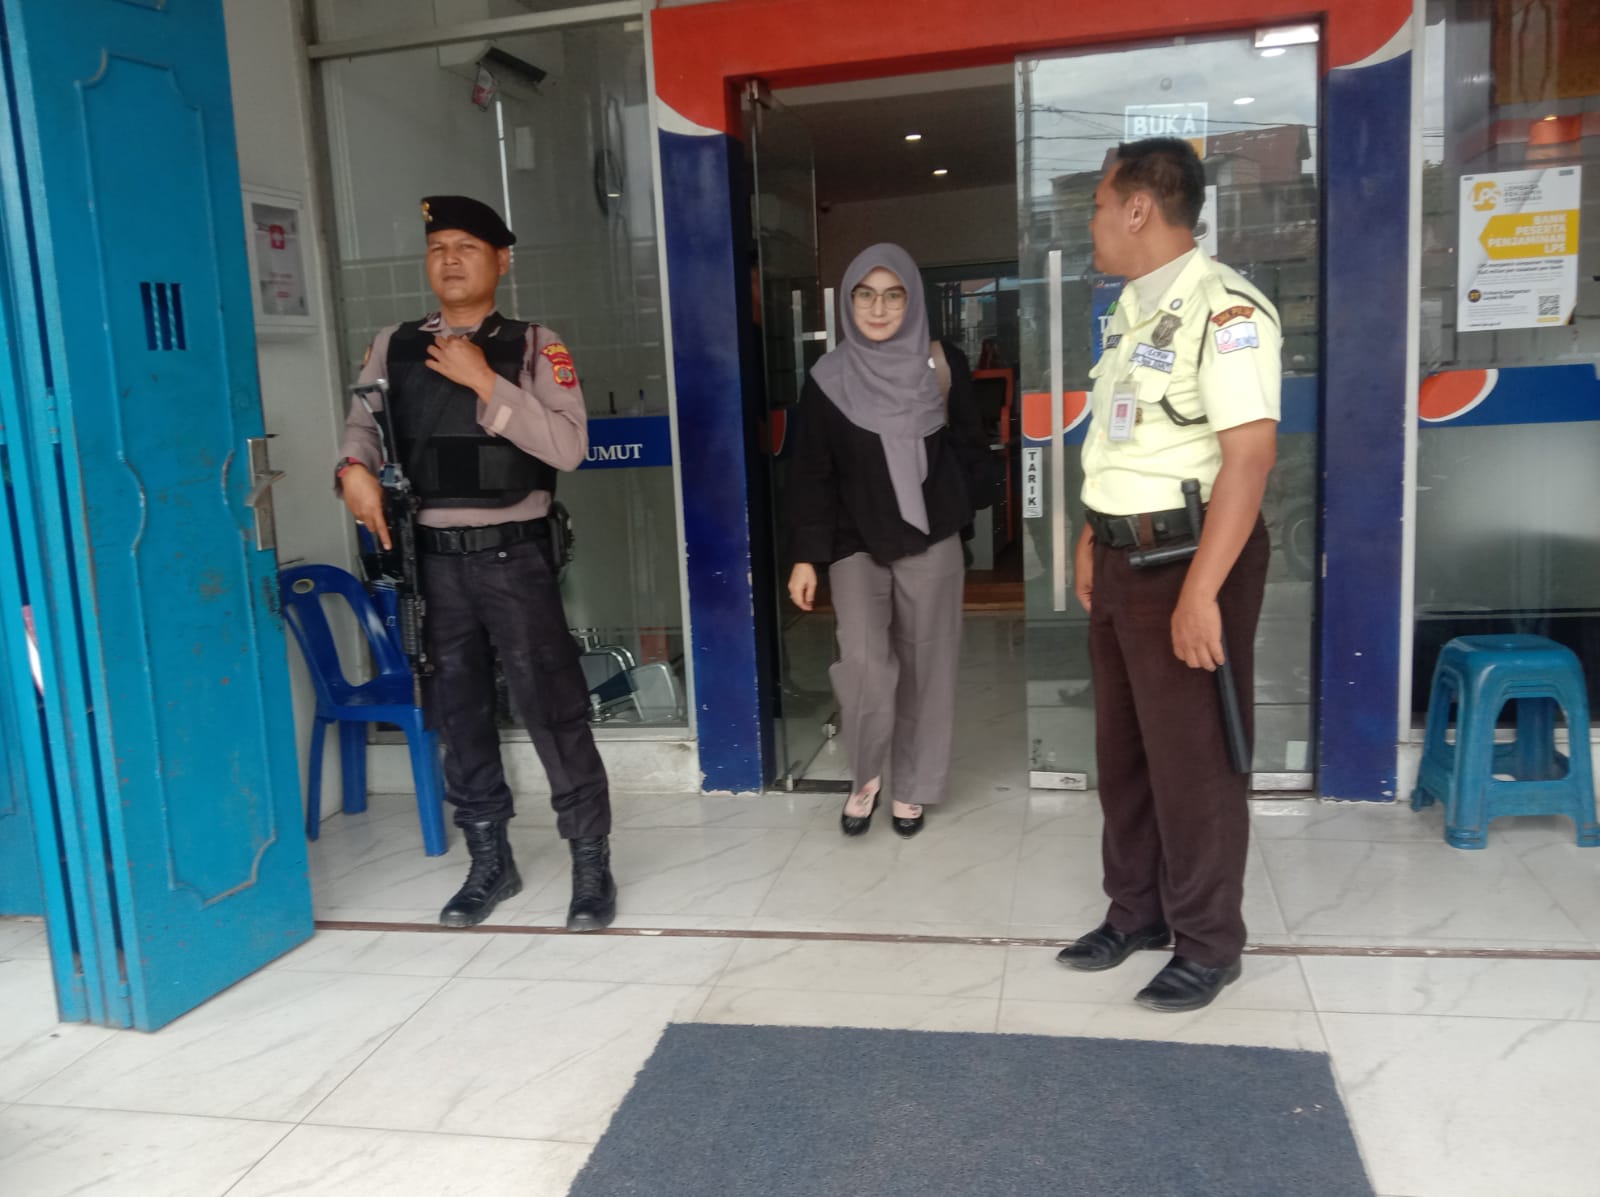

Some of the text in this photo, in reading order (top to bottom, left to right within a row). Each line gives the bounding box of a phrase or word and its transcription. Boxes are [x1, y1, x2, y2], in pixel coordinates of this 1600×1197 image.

[1134, 112, 1196, 135] BUKA
[1534, 213, 1566, 225] BANK
[1516, 223, 1566, 236] PESERTA
[1488, 234, 1566, 248] PENJAMINAN
[1544, 243, 1566, 254] LPS
[1028, 452, 1037, 506] TARIK
